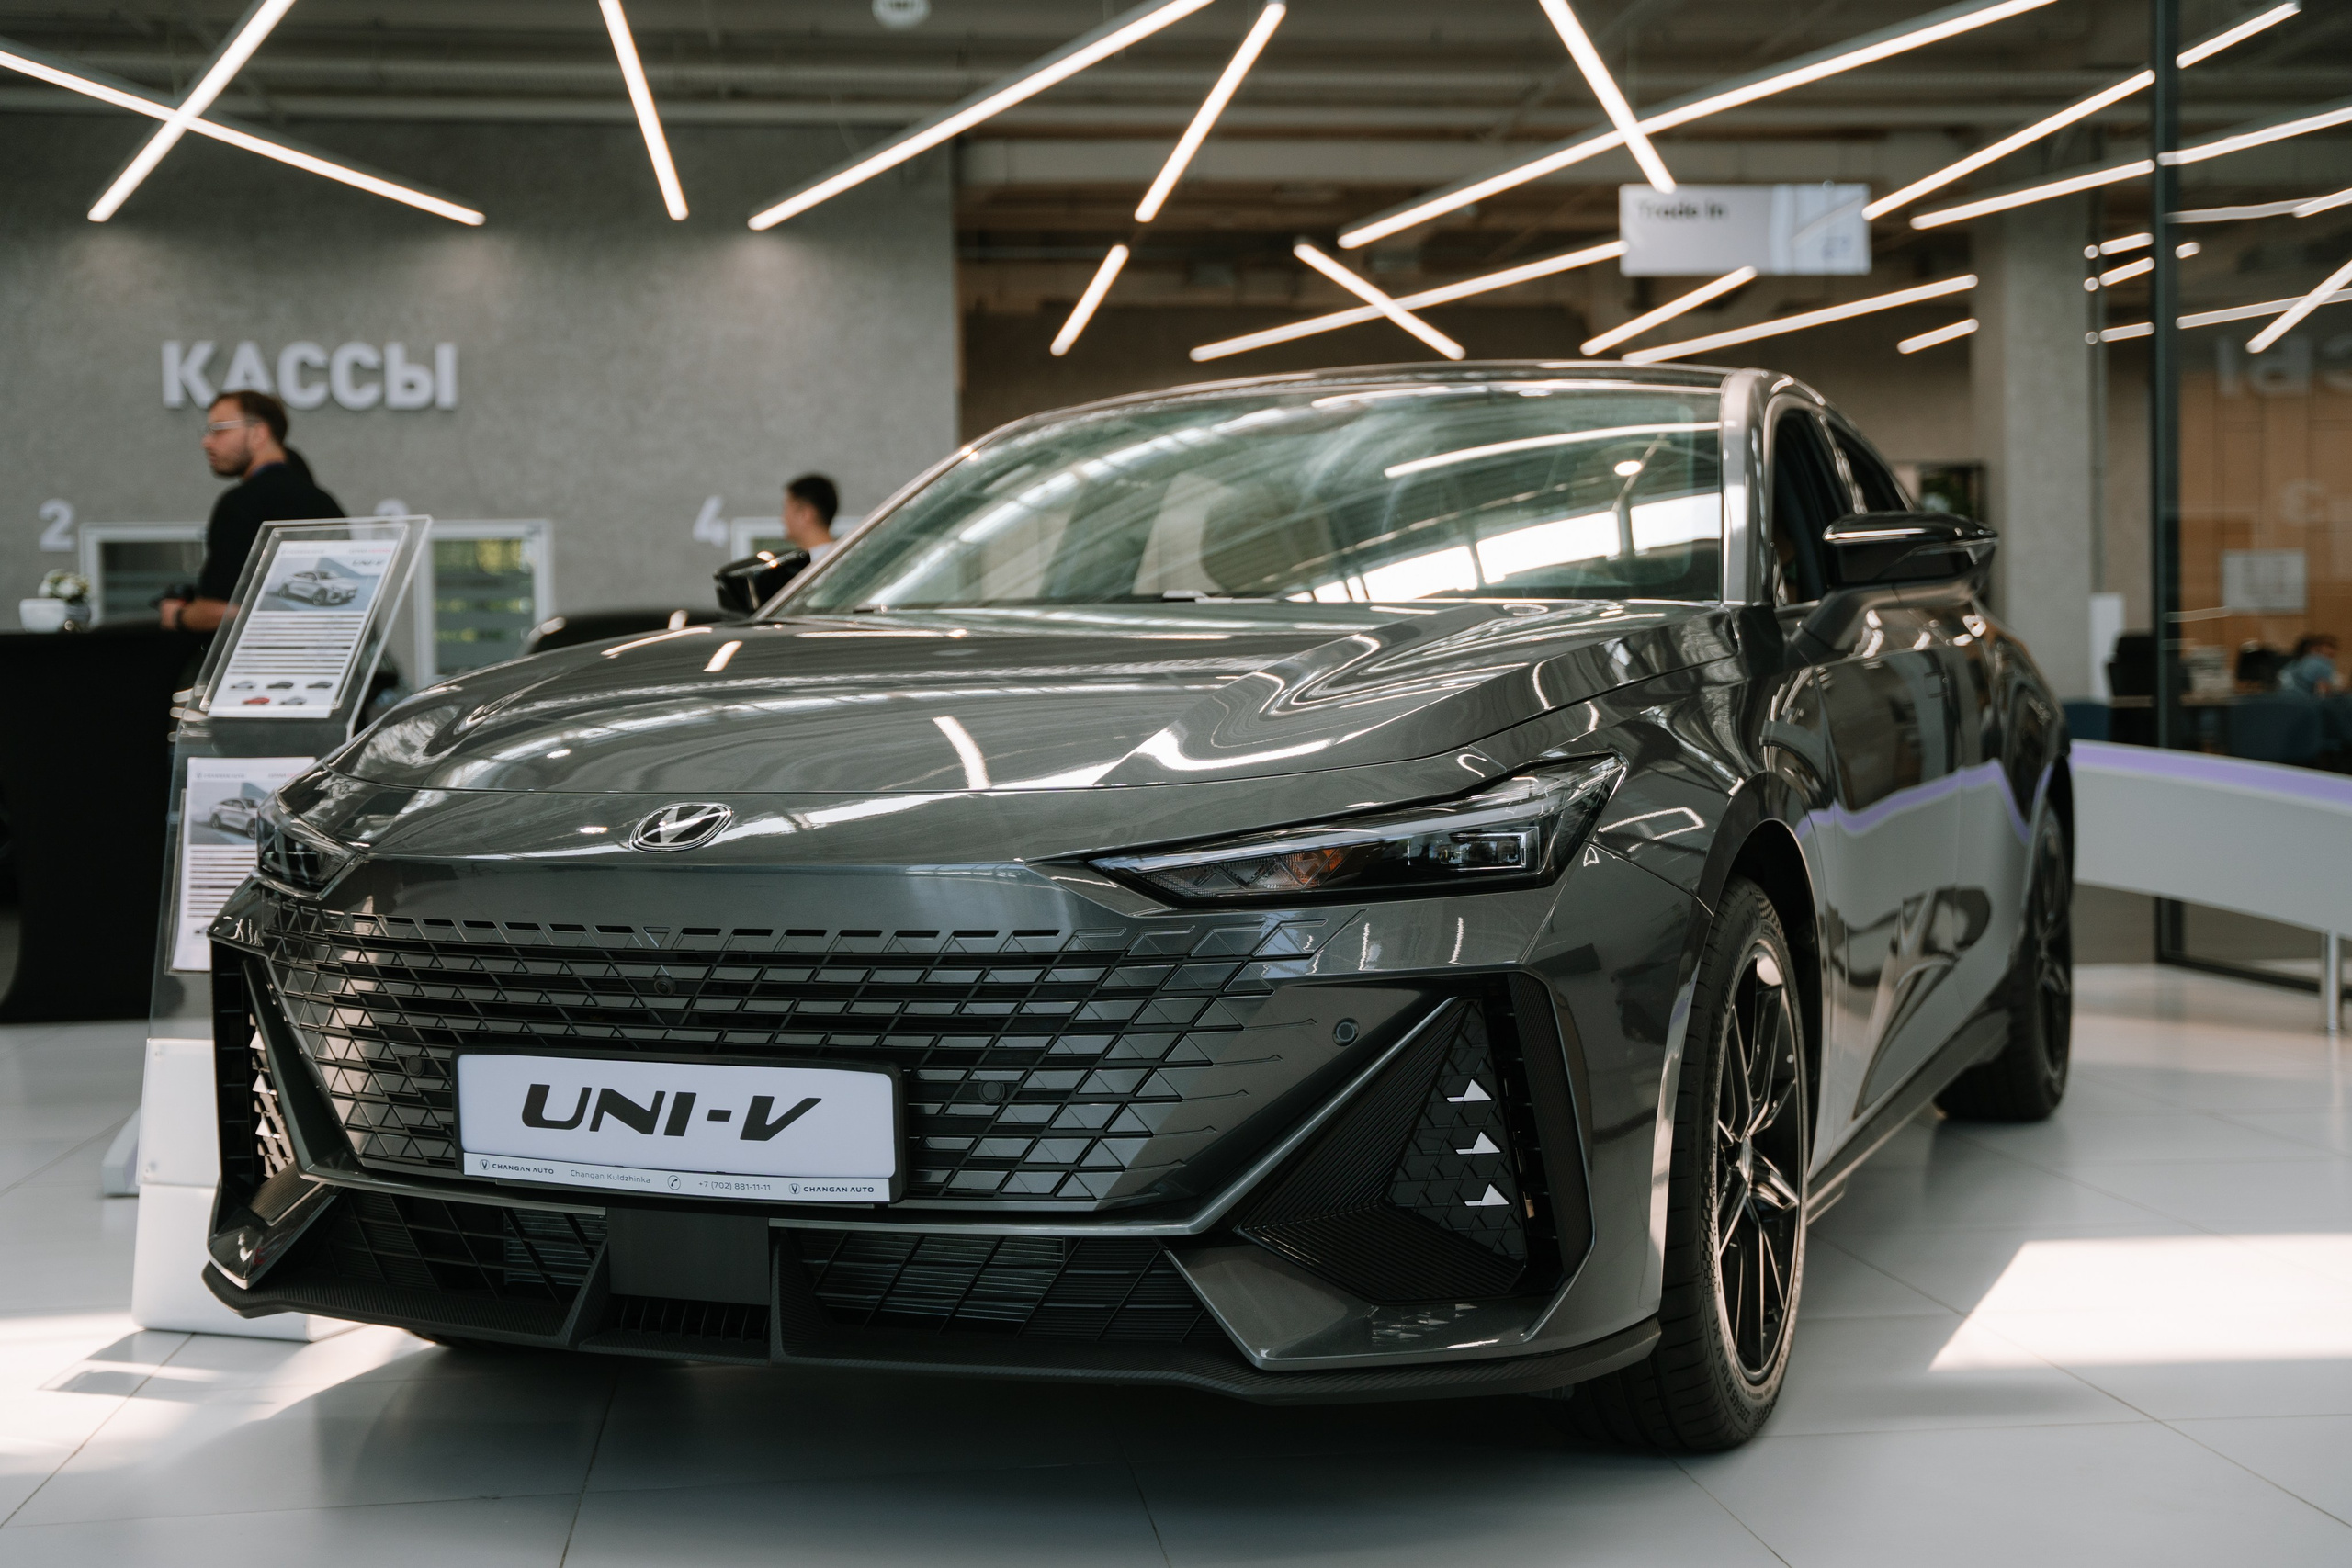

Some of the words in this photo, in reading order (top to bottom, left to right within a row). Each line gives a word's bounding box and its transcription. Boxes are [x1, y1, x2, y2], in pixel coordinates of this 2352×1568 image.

[160, 340, 458, 411] КАССЫ
[38, 498, 74, 551] 2
[692, 496, 728, 547] 4
[521, 1083, 822, 1142] UNI-V
[492, 1163, 531, 1172] CHANGAN
[532, 1167, 555, 1175] AUTO
[570, 1169, 605, 1179] Changan
[606, 1173, 650, 1184] Kuldzhinka
[711, 1181, 732, 1190] (702)
[734, 1182, 771, 1190] 881-11-11
